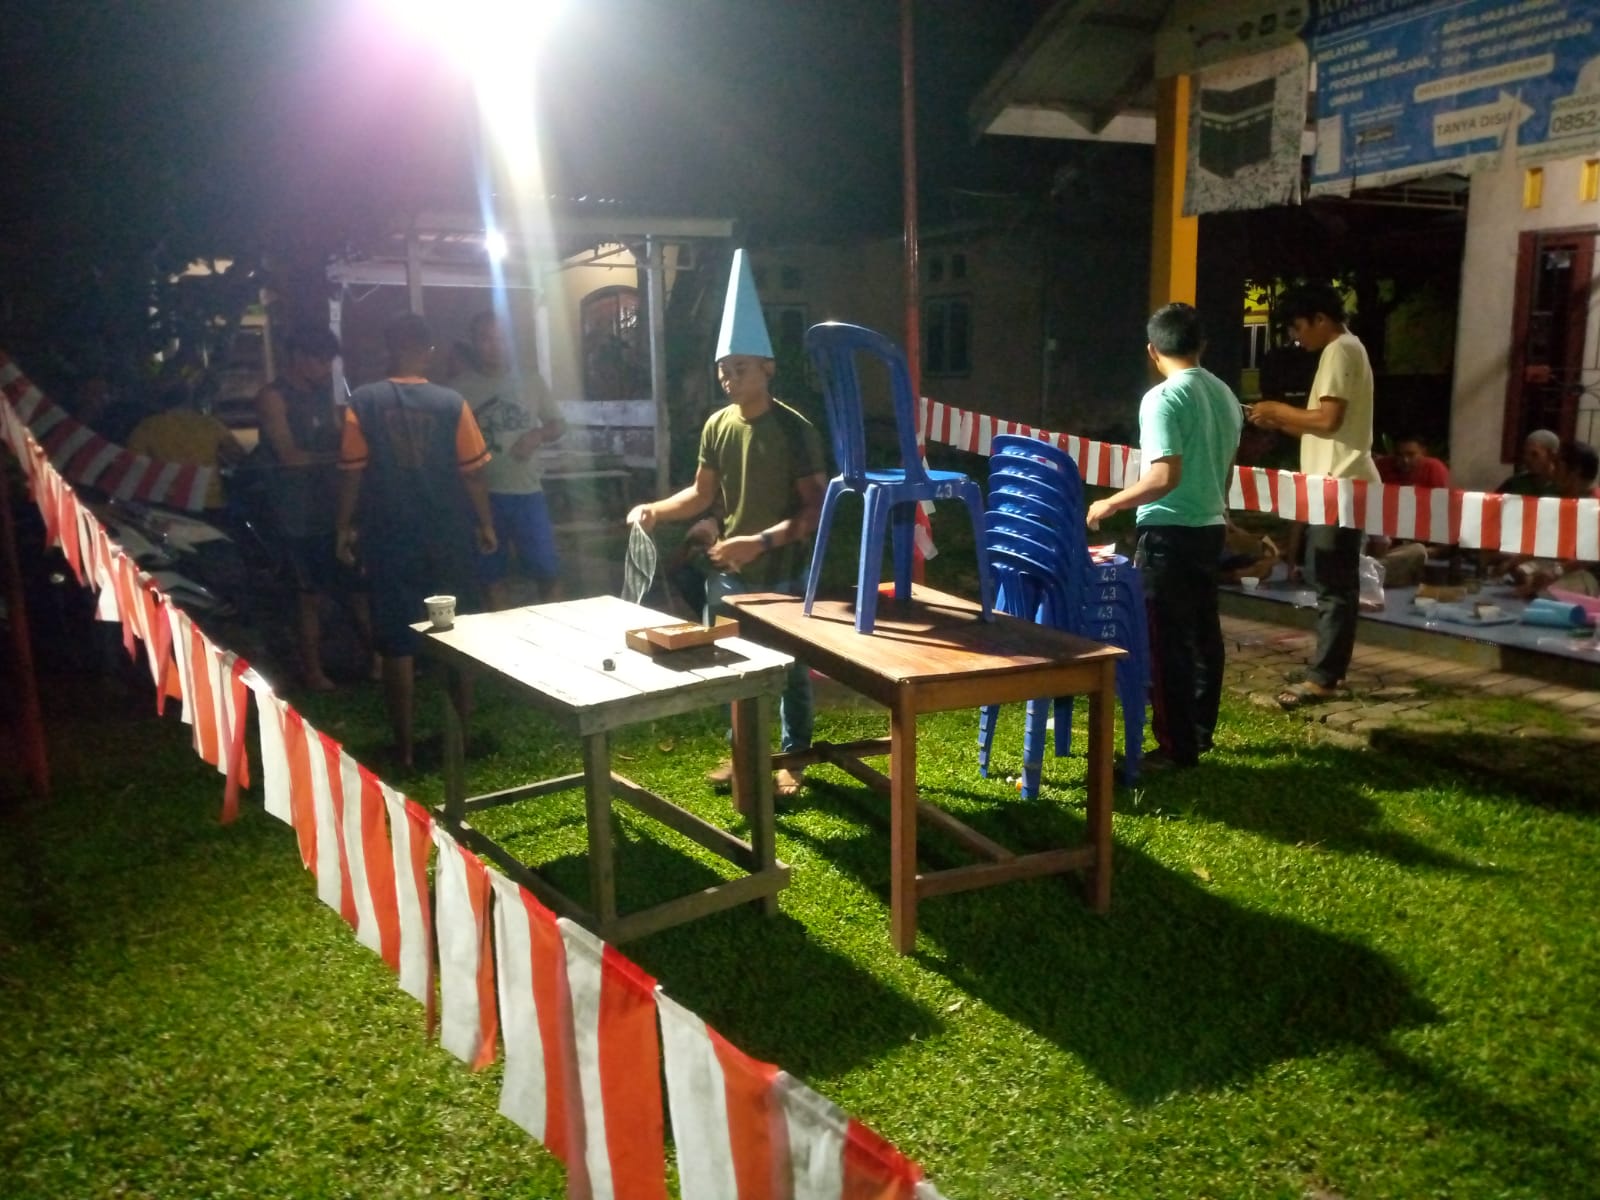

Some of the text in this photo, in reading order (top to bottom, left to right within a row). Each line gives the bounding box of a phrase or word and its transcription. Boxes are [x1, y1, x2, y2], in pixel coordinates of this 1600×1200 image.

[1437, 117, 1476, 136] TANYA
[935, 484, 953, 498] 43
[1102, 568, 1117, 582] 43
[1101, 587, 1116, 601] 43
[1098, 606, 1113, 619] 43
[1101, 624, 1116, 638] 43
